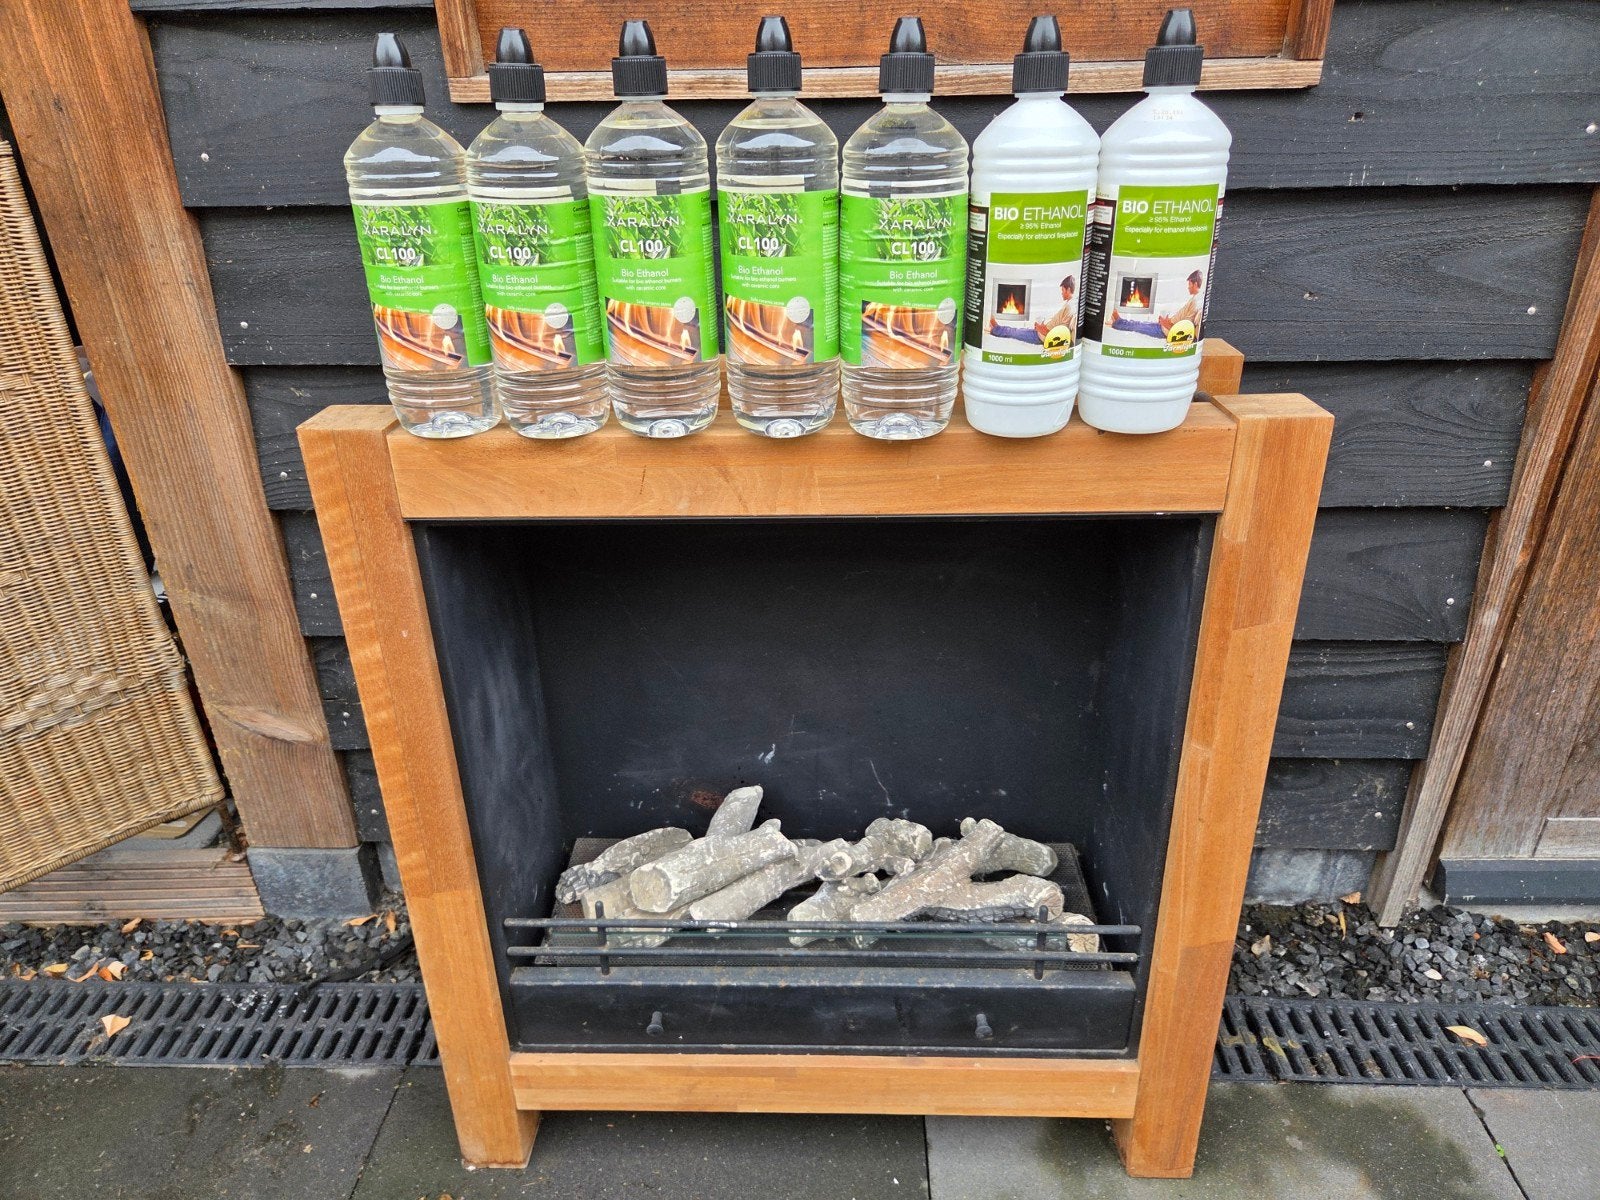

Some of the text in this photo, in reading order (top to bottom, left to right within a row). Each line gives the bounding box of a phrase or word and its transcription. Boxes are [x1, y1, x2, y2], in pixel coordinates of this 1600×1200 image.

[1122, 198, 1214, 214] BIO ETHANOL
[994, 205, 1084, 221] BIO ETHANOL
[607, 216, 679, 227] XARALYN
[879, 218, 952, 230] XARALYN
[1125, 226, 1153, 234] Especially
[998, 233, 1024, 241] Especially
[620, 239, 664, 253] CL100
[738, 236, 779, 250] CL100
[891, 241, 936, 255] CL100
[376, 247, 416, 260] CL100
[489, 246, 531, 259] CL100
[621, 268, 669, 278] Bio Ethanol
[738, 265, 783, 275] Bio Ethanol
[889, 269, 938, 280] Bio Ethanol
[380, 274, 424, 284] Bio Ethanol
[492, 274, 538, 284] Bio Ethanol
[1109, 348, 1124, 356] 1000
[988, 354, 1004, 362] 1000
